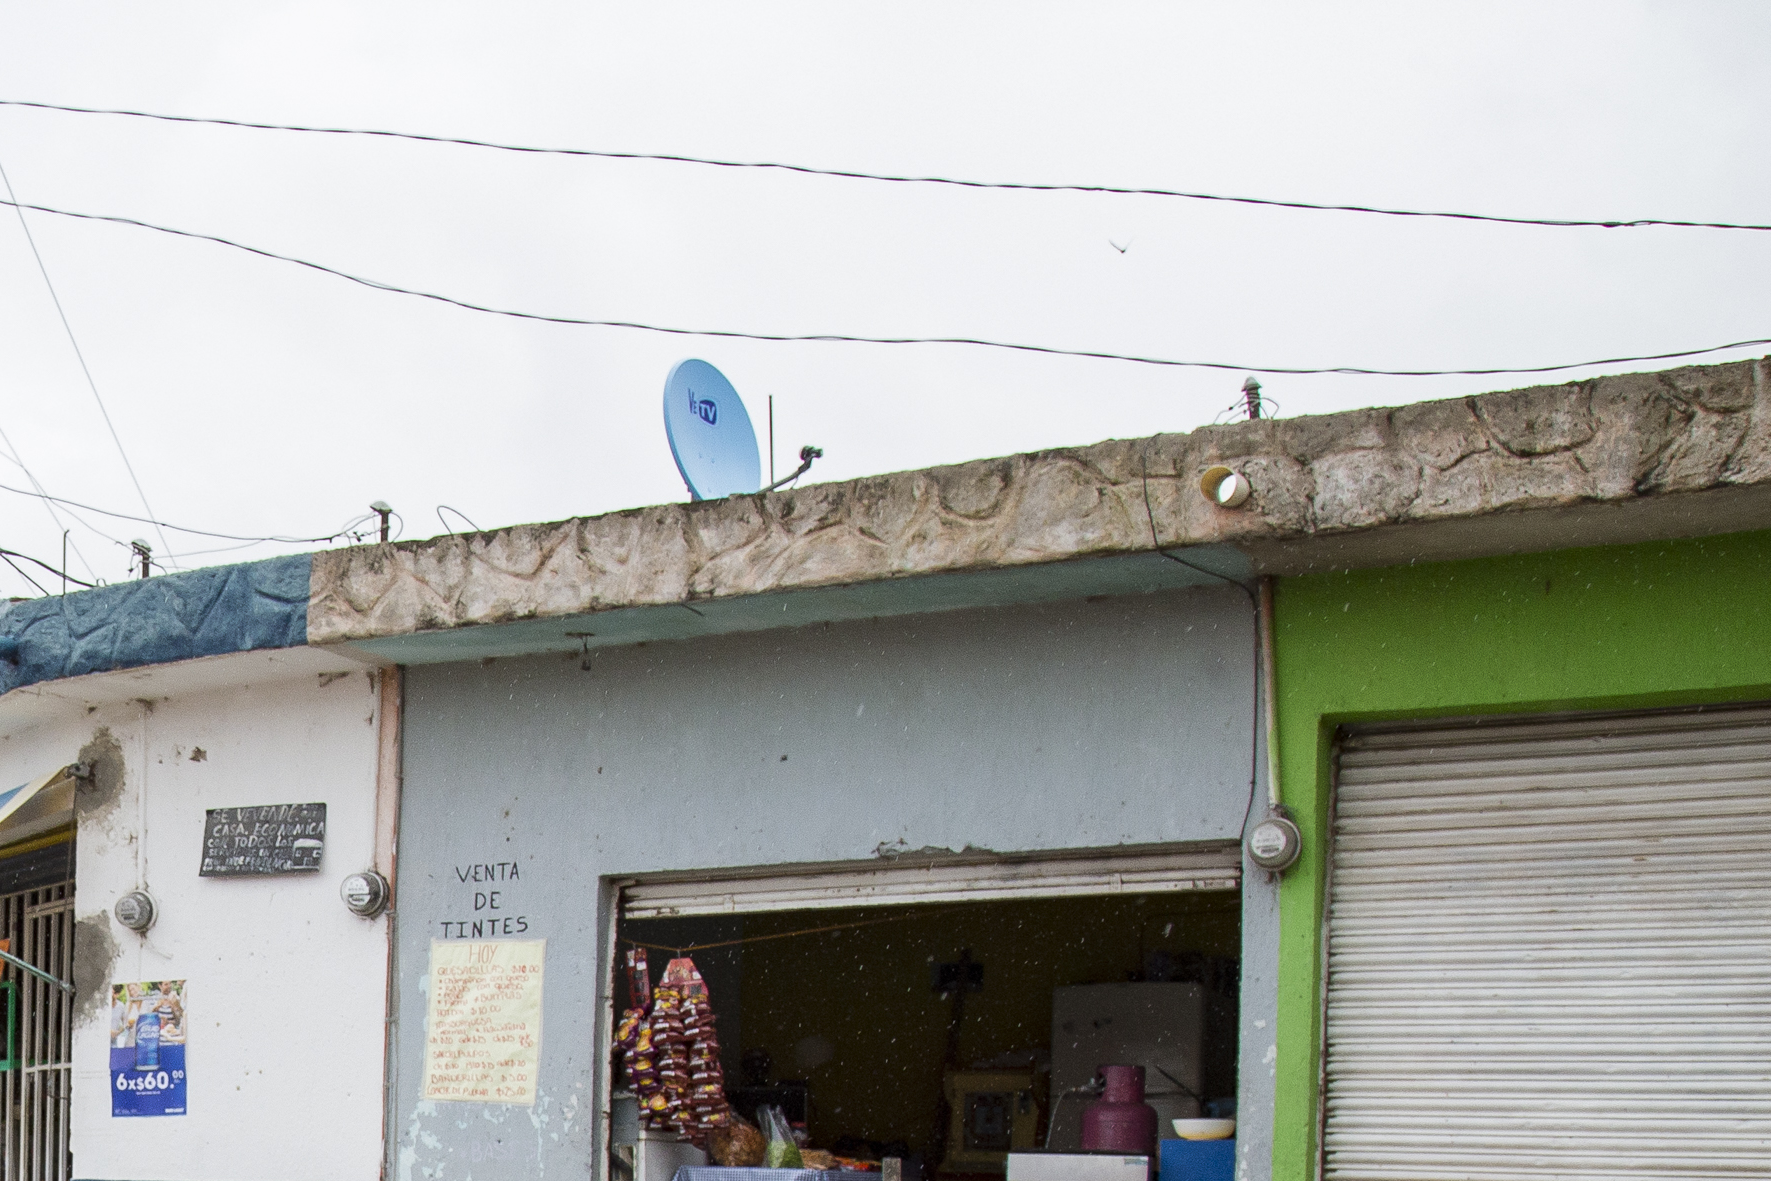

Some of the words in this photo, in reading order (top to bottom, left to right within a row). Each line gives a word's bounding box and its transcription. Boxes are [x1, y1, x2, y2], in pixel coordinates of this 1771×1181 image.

[213, 808, 229, 822] SE
[253, 821, 325, 836] ECONOMICA
[234, 835, 274, 849] TODOS
[455, 861, 520, 883] VENTA
[474, 891, 501, 911] DE
[440, 916, 528, 939] TINTES
[468, 944, 499, 965] HOY
[437, 964, 505, 976] QUESADILLAS
